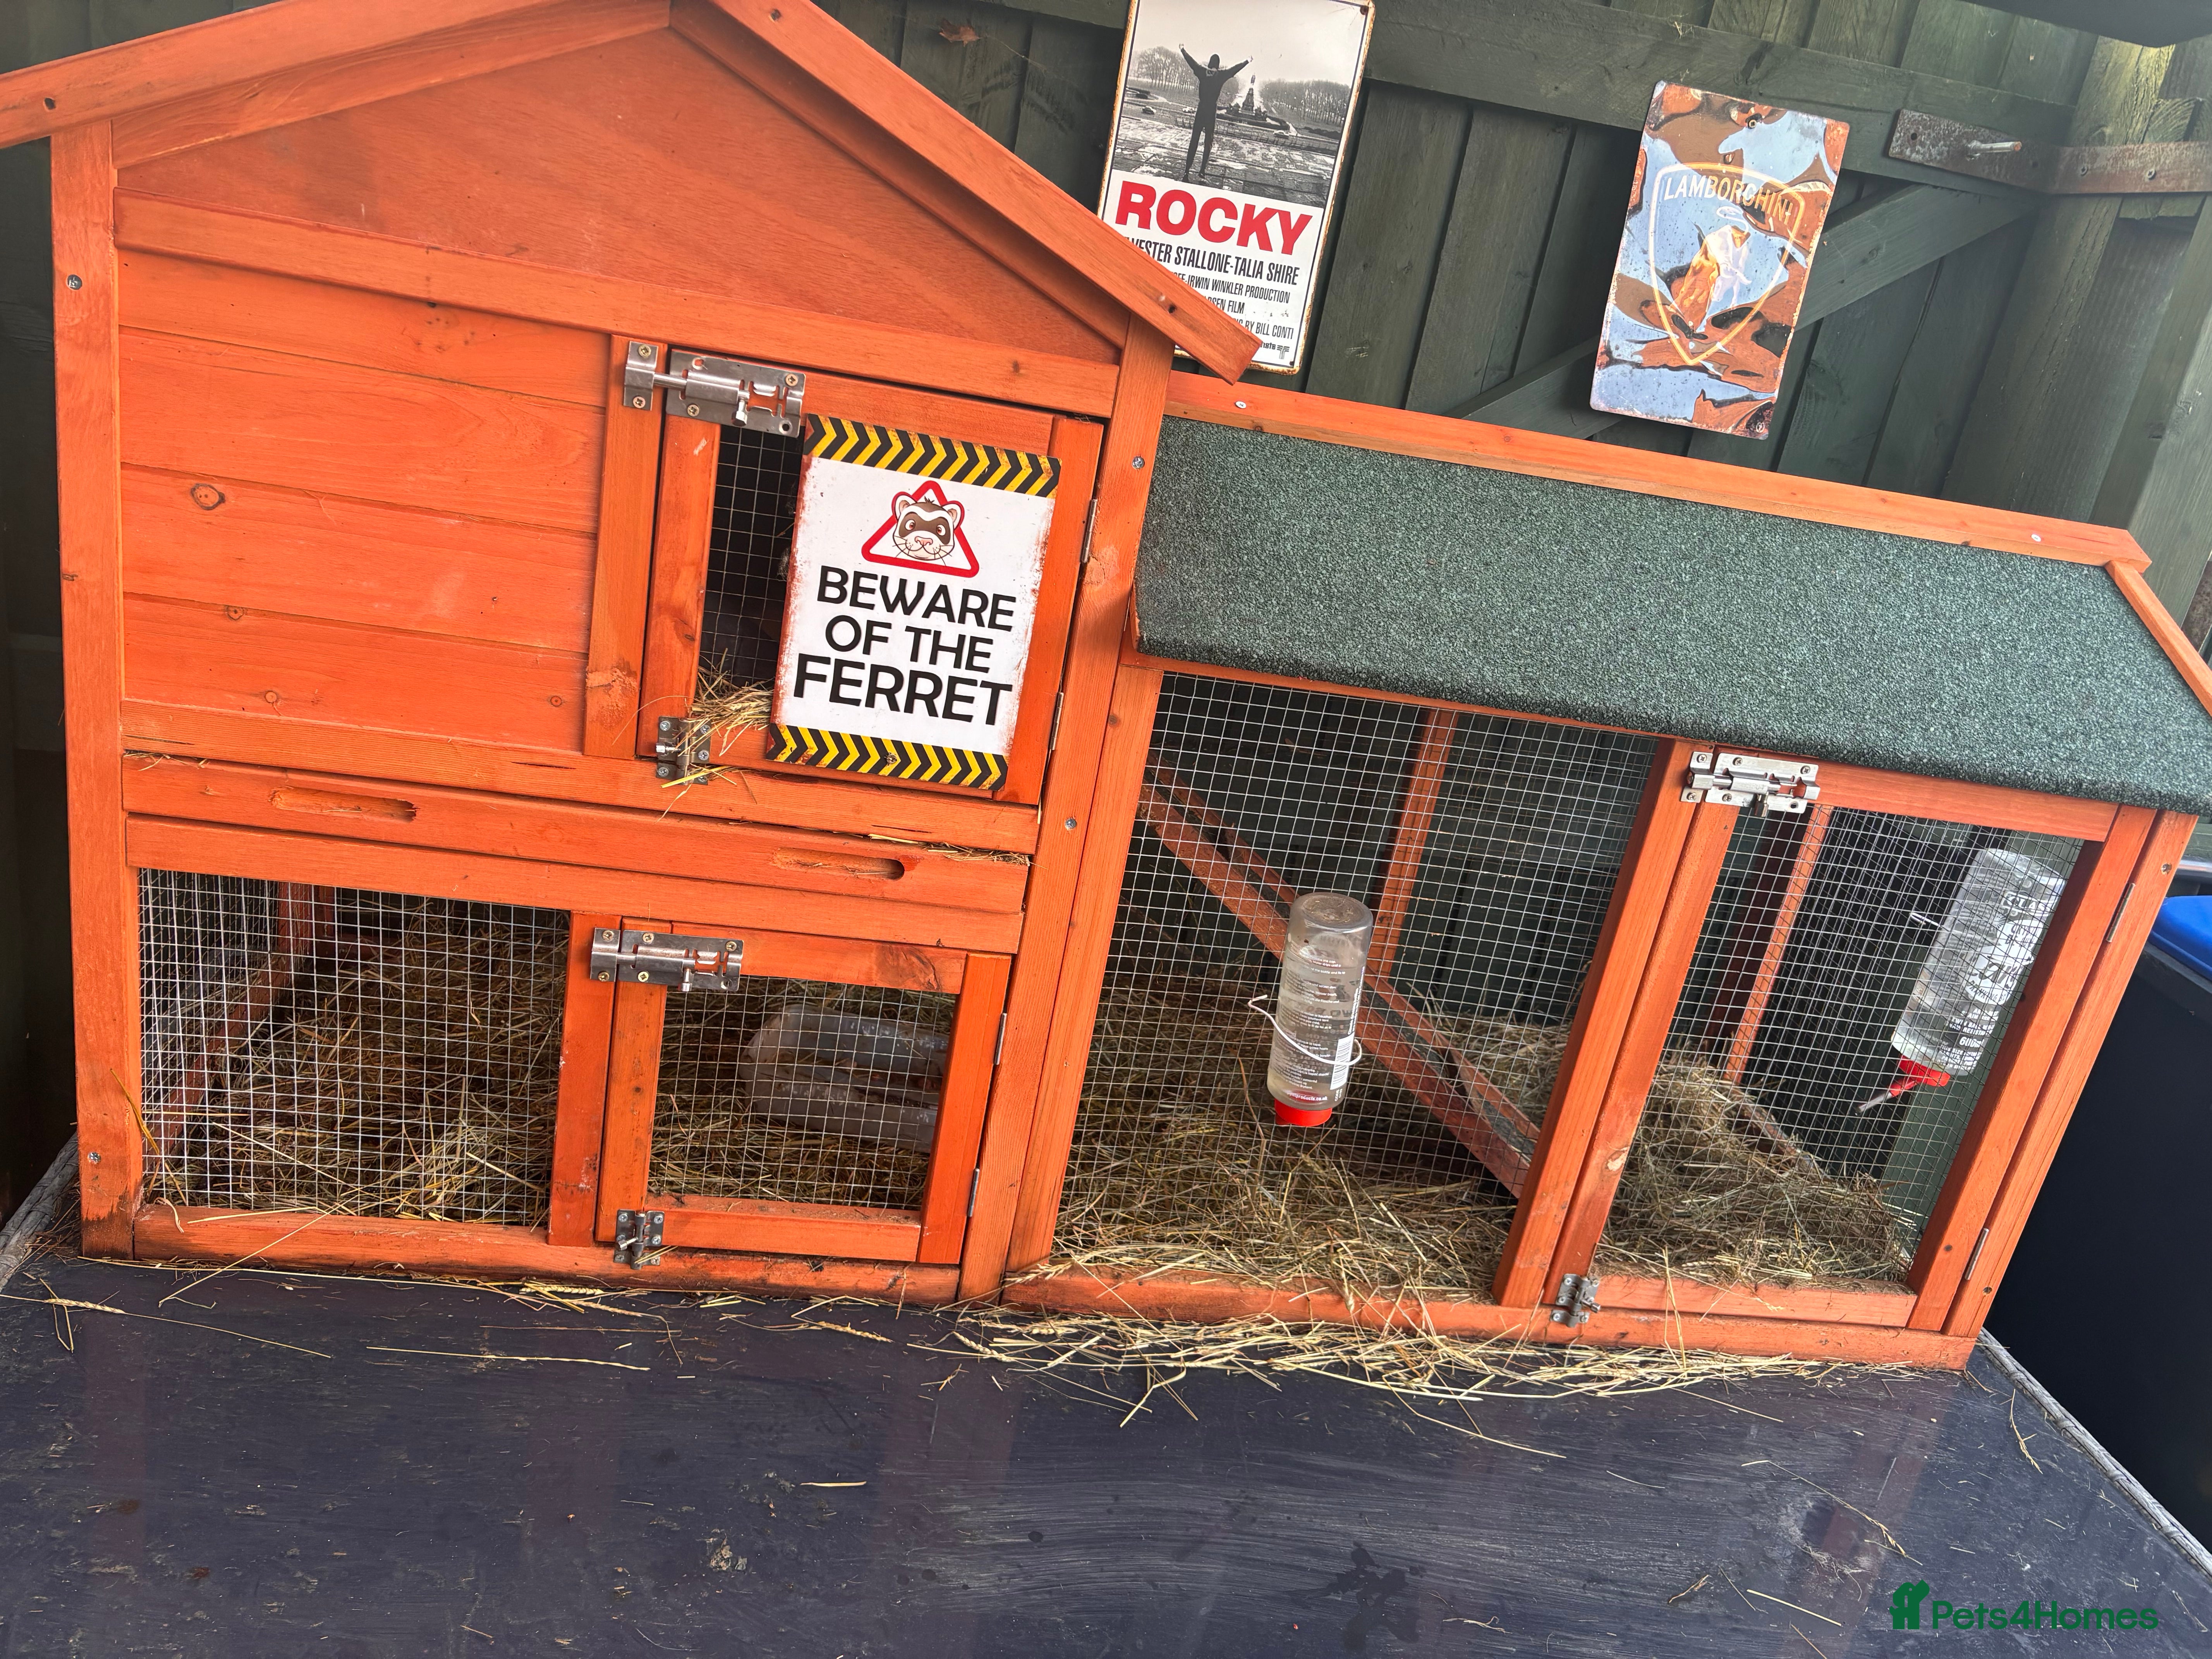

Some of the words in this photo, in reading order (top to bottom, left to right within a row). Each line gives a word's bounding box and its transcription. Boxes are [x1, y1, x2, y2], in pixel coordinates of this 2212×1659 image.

[1115, 180, 1312, 255] ROCKY
[1663, 175, 1793, 224] LAMBORGHINI
[1174, 246, 1264, 280] STALLONE-TALIA
[1266, 262, 1300, 285] SHIRE
[1211, 279, 1243, 295] WINKLER
[1245, 285, 1290, 304] PRODUCTION
[1227, 300, 1245, 314] FILM
[1255, 322, 1269, 335] BILL
[1272, 325, 1294, 339] CONTI
[817, 565, 1016, 632] BEWARE
[825, 615, 892, 655] OF
[905, 625, 993, 673] THE
[793, 653, 1013, 726] FERRET
